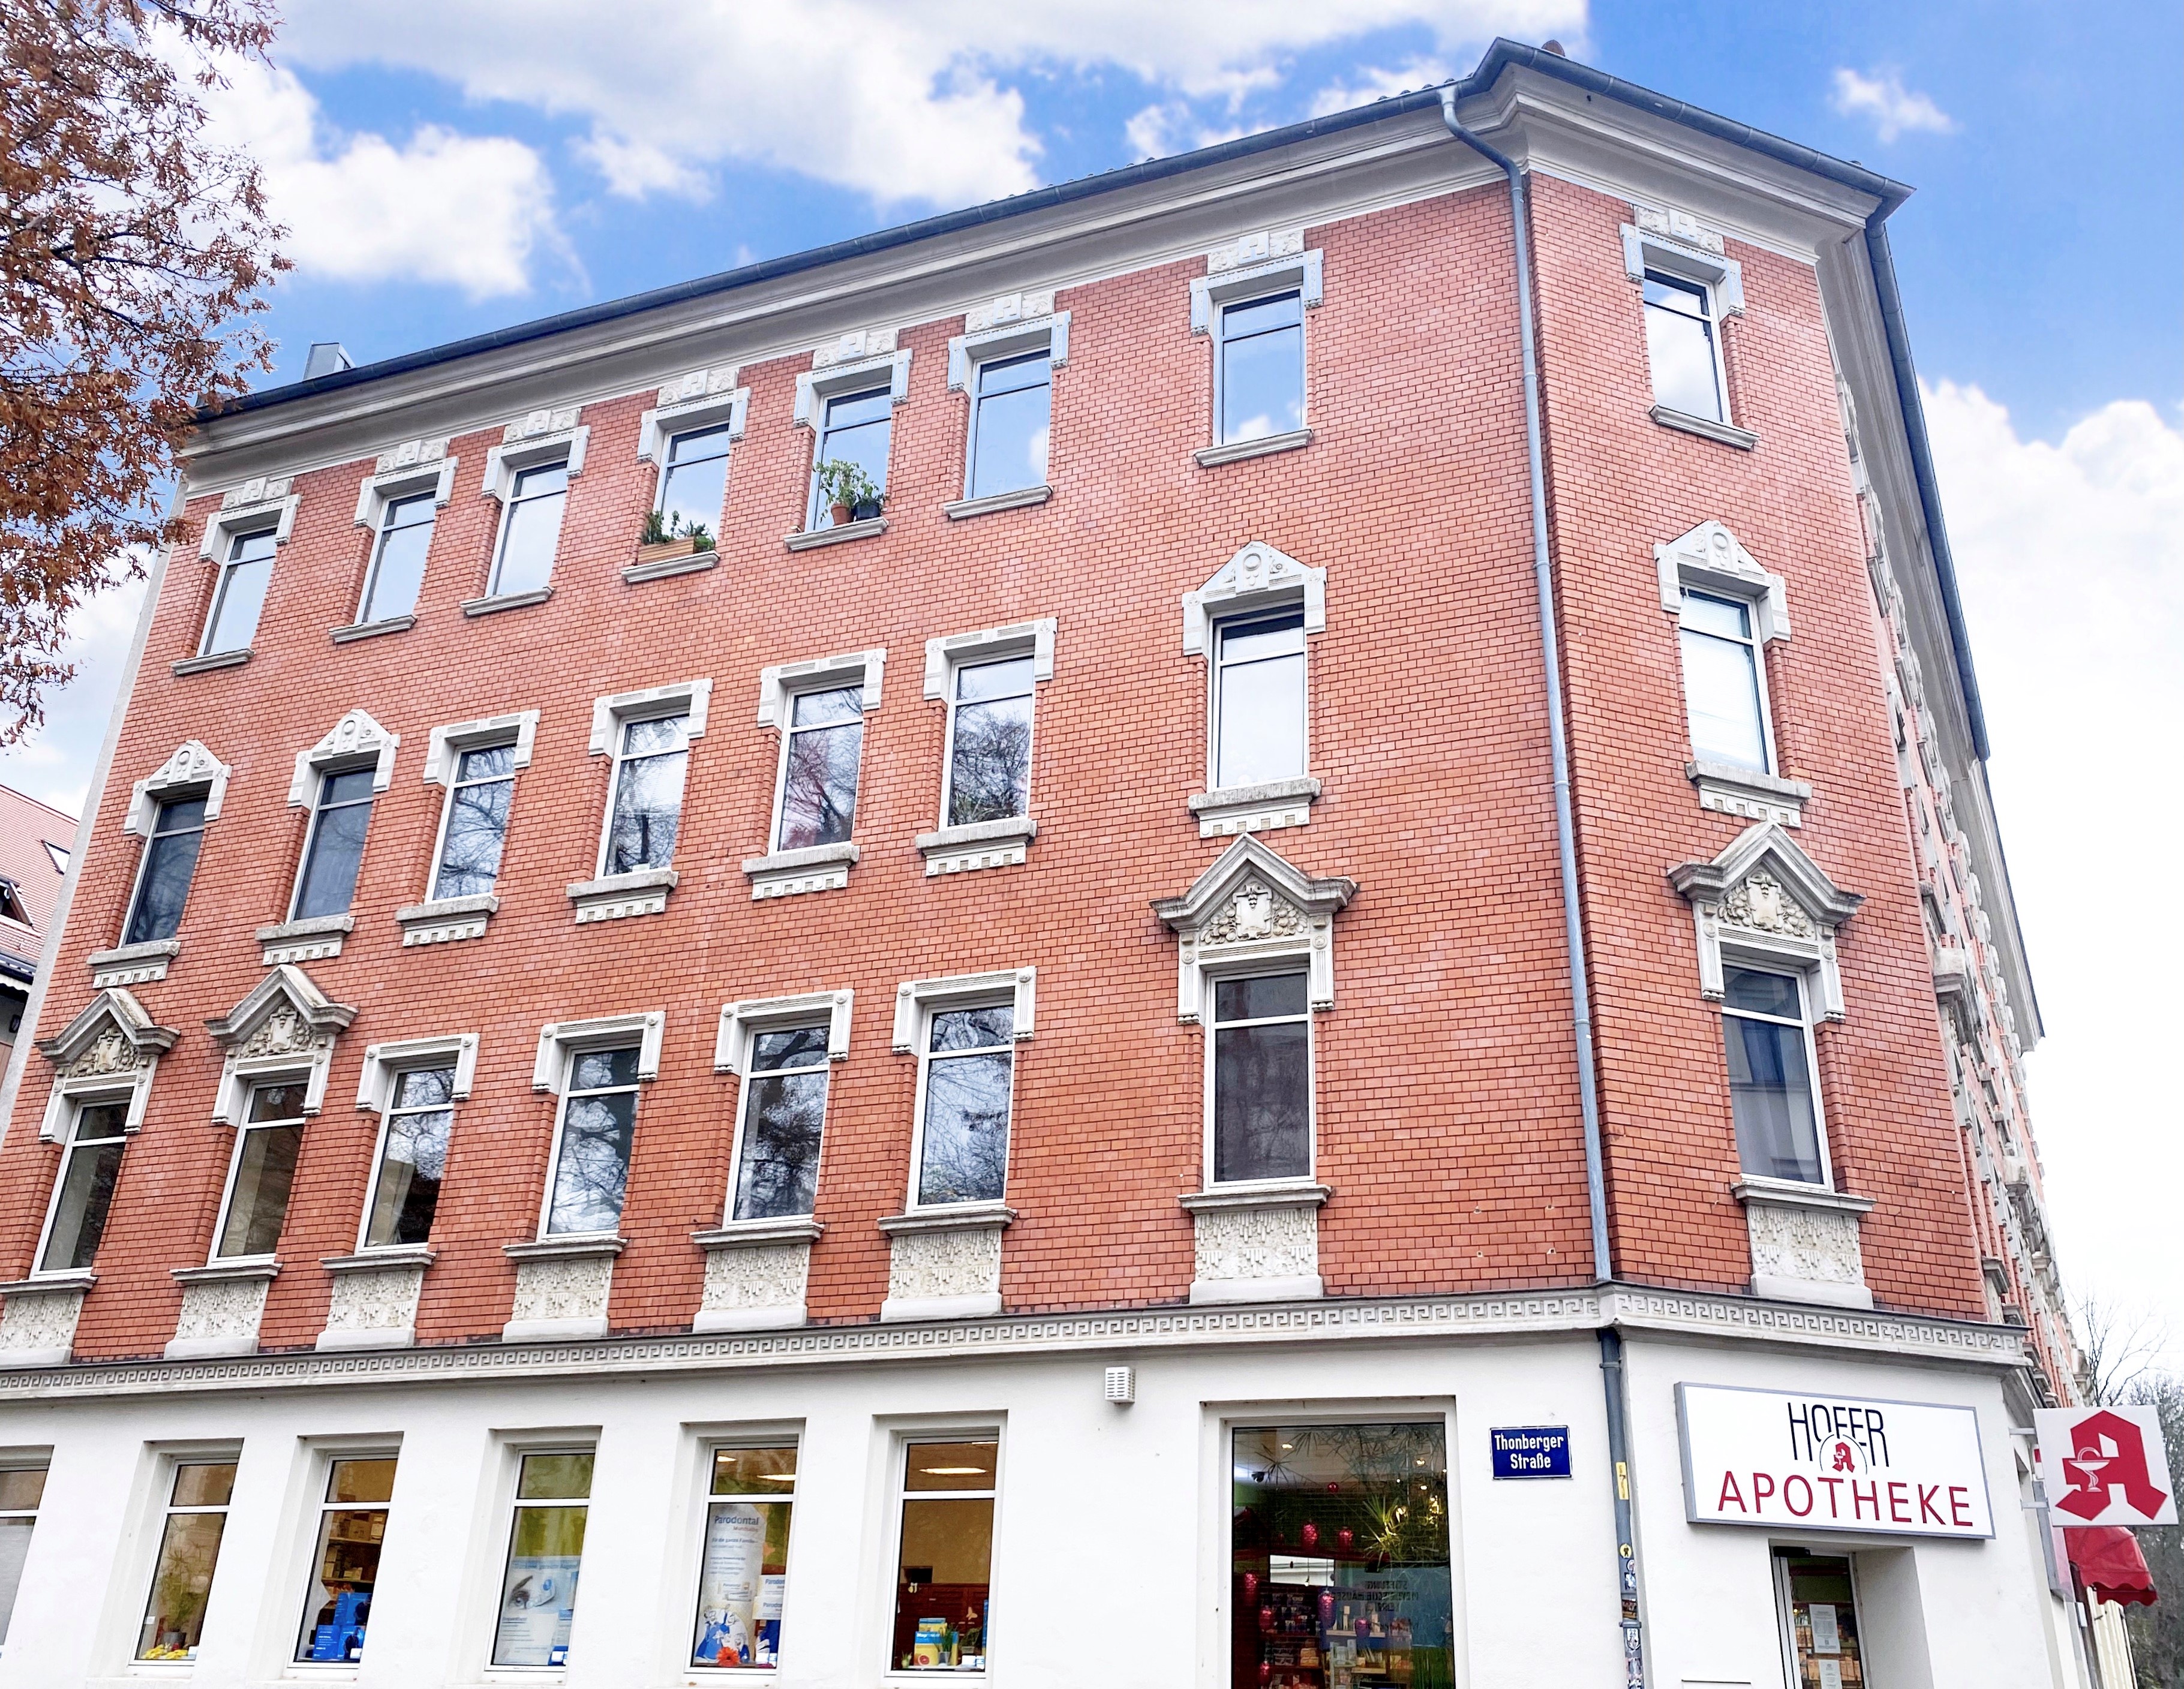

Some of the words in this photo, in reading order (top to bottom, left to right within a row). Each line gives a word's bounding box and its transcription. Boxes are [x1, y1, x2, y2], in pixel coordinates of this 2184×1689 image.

[1494, 1432, 1564, 1453] Thonberger
[1787, 1402, 1889, 1467] HOFER
[1510, 1452, 1551, 1469] Straße
[1717, 1470, 1973, 1527] APOTHEKE
[714, 1515, 760, 1525] Parodontal
